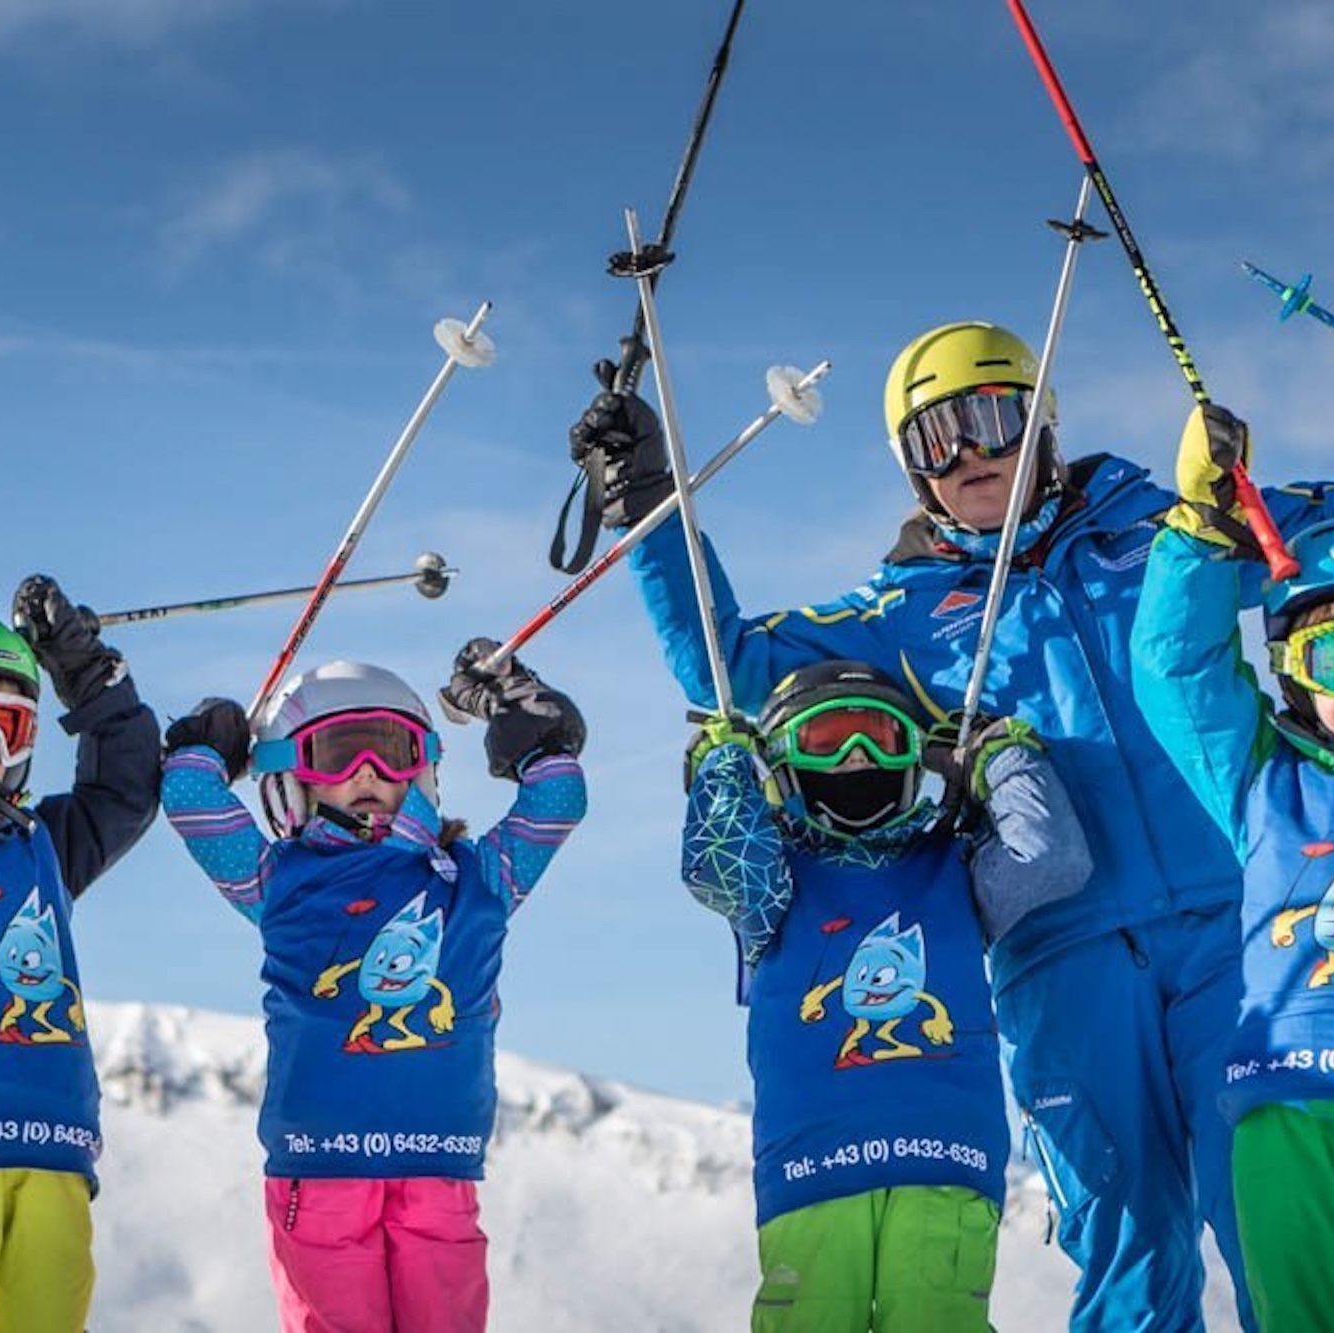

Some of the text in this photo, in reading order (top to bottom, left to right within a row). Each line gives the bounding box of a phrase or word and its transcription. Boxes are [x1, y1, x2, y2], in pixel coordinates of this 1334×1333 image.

[1267, 1050, 1315, 1072] +43
[22, 1120, 51, 1145] (0)
[284, 1132, 482, 1157] Tel: +43 (0) 6432-6339
[783, 1137, 988, 1182] Tel: +43 (0) 6432-6339
